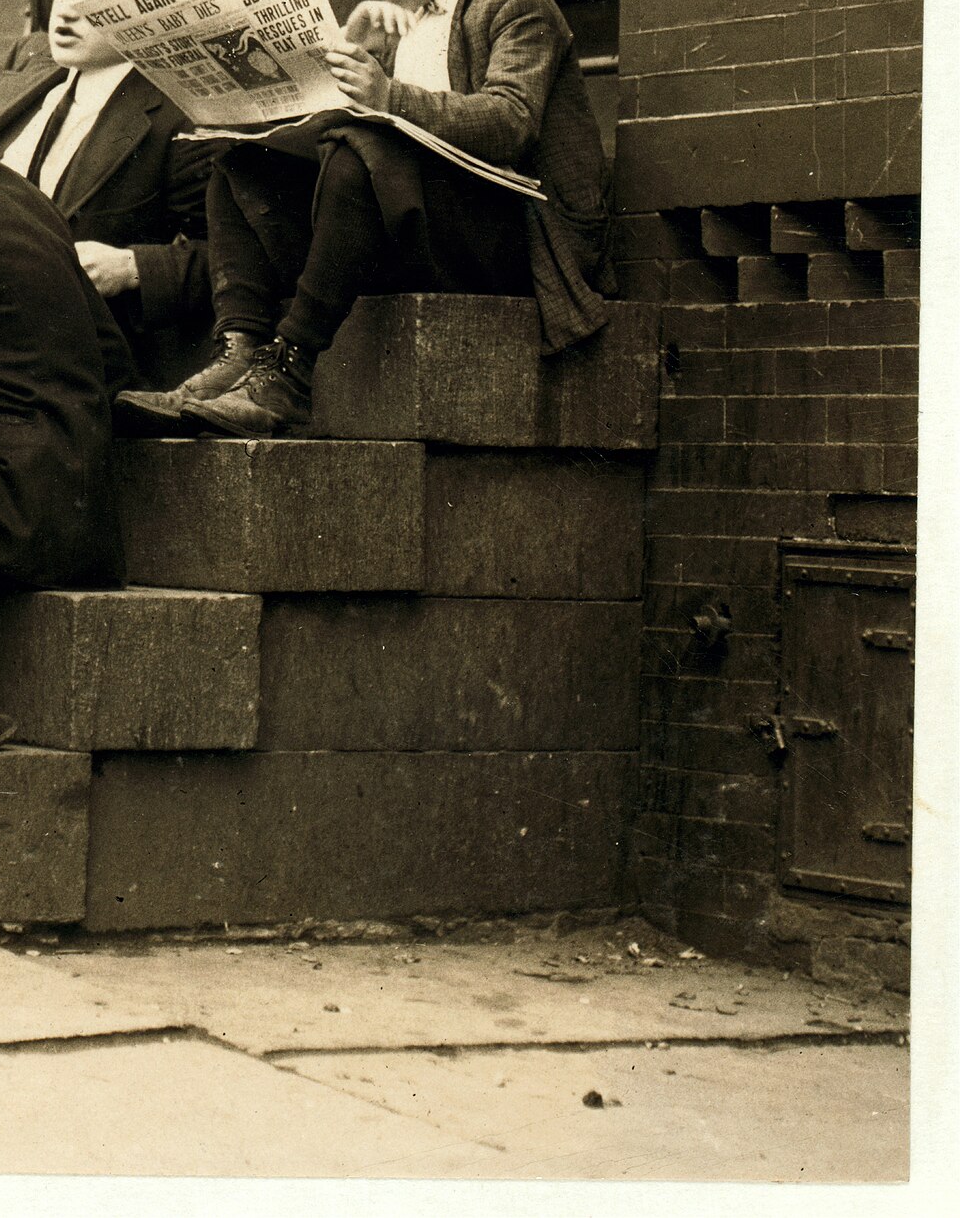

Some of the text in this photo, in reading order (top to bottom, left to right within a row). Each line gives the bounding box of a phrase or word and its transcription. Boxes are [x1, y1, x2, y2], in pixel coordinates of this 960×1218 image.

[157, 10, 189, 32] BABY
[193, 0, 221, 21] DIES
[257, 14, 307, 43] RESCUES
[309, 7, 325, 24] IN
[167, 35, 198, 54] STORY
[272, 26, 324, 55] FLAT FIRE.
[168, 49, 208, 68] FUNERAL
